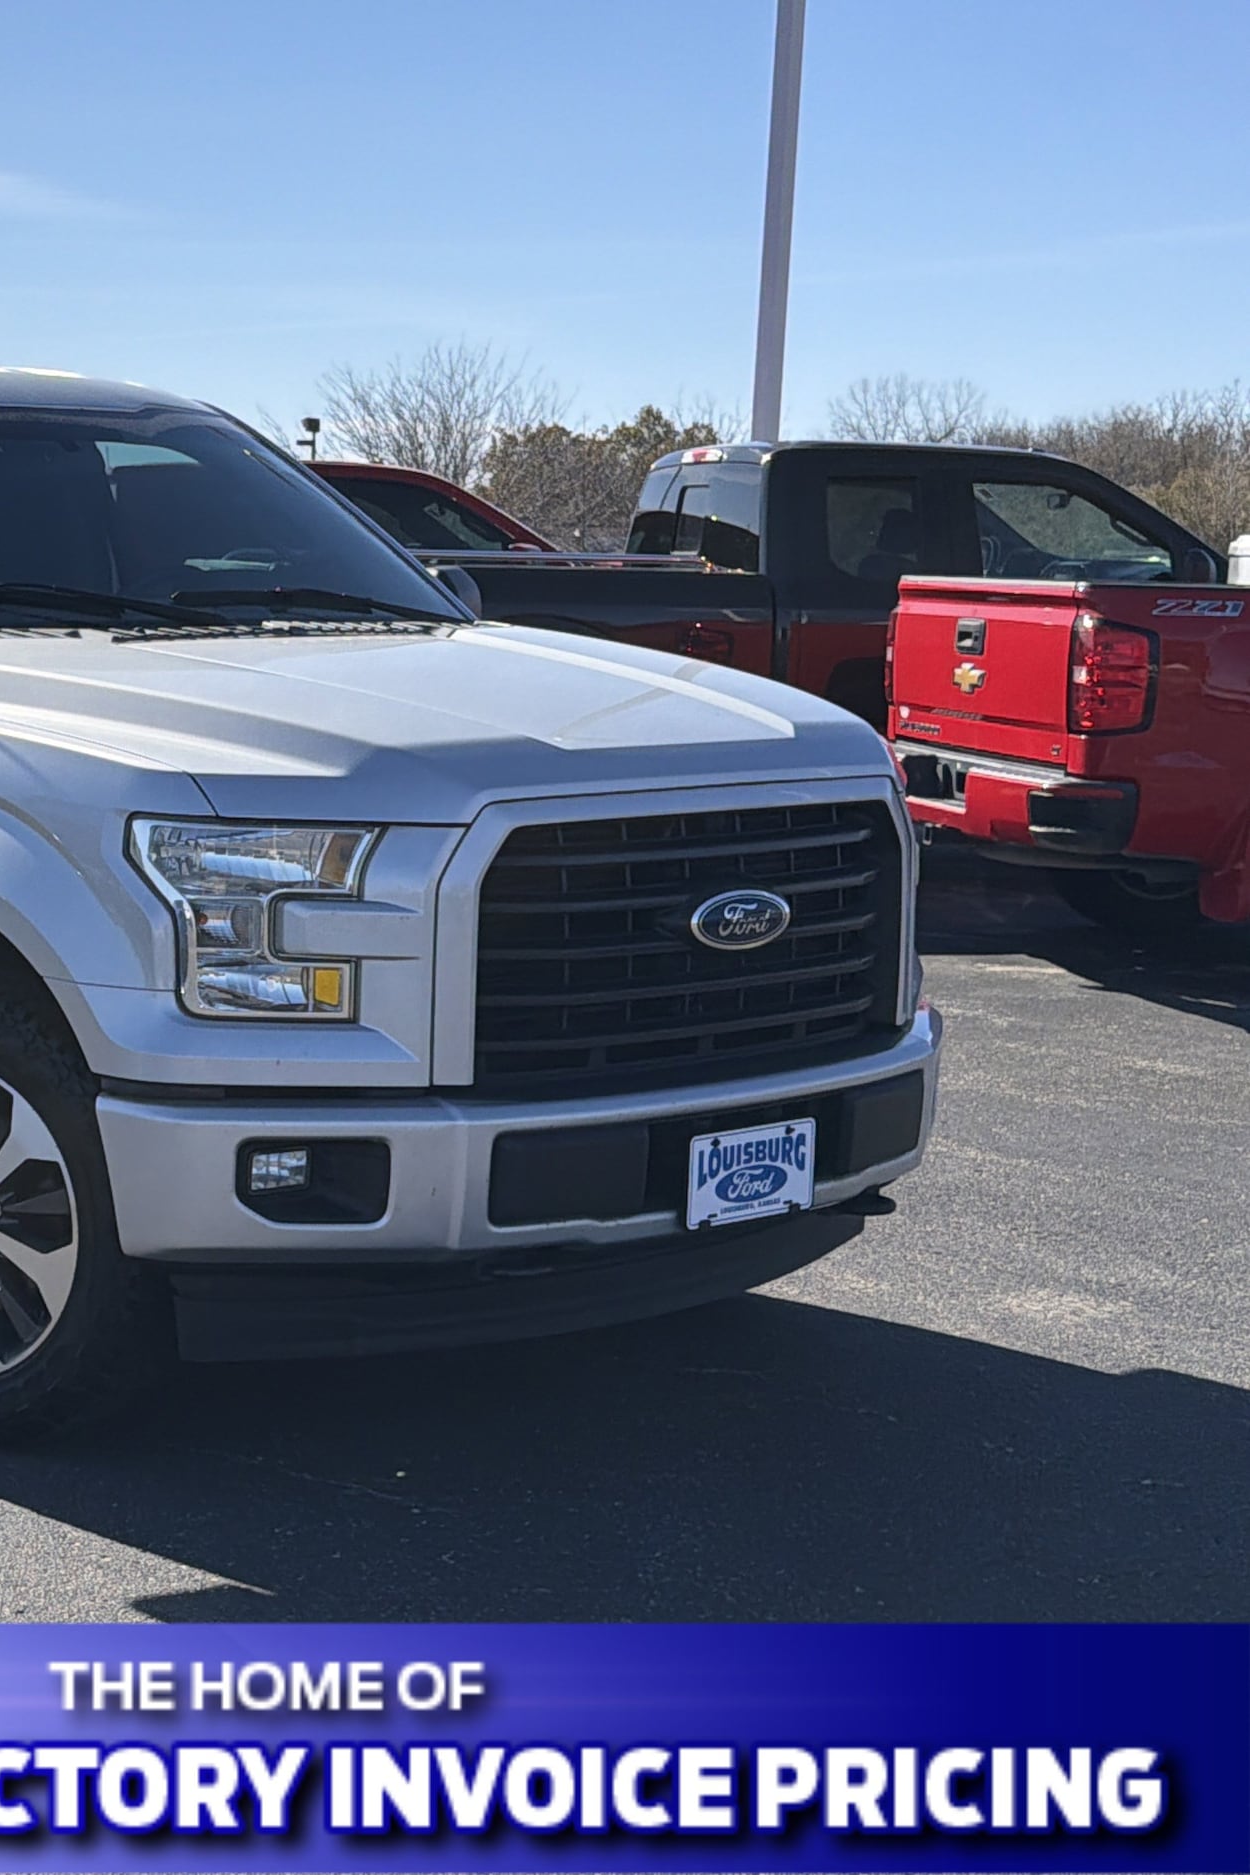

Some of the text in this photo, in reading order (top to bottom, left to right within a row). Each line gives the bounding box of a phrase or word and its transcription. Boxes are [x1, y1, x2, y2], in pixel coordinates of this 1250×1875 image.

[718, 903, 771, 936] Ford
[697, 1133, 806, 1191] LOUISBURG
[727, 1168, 775, 1199] Ford
